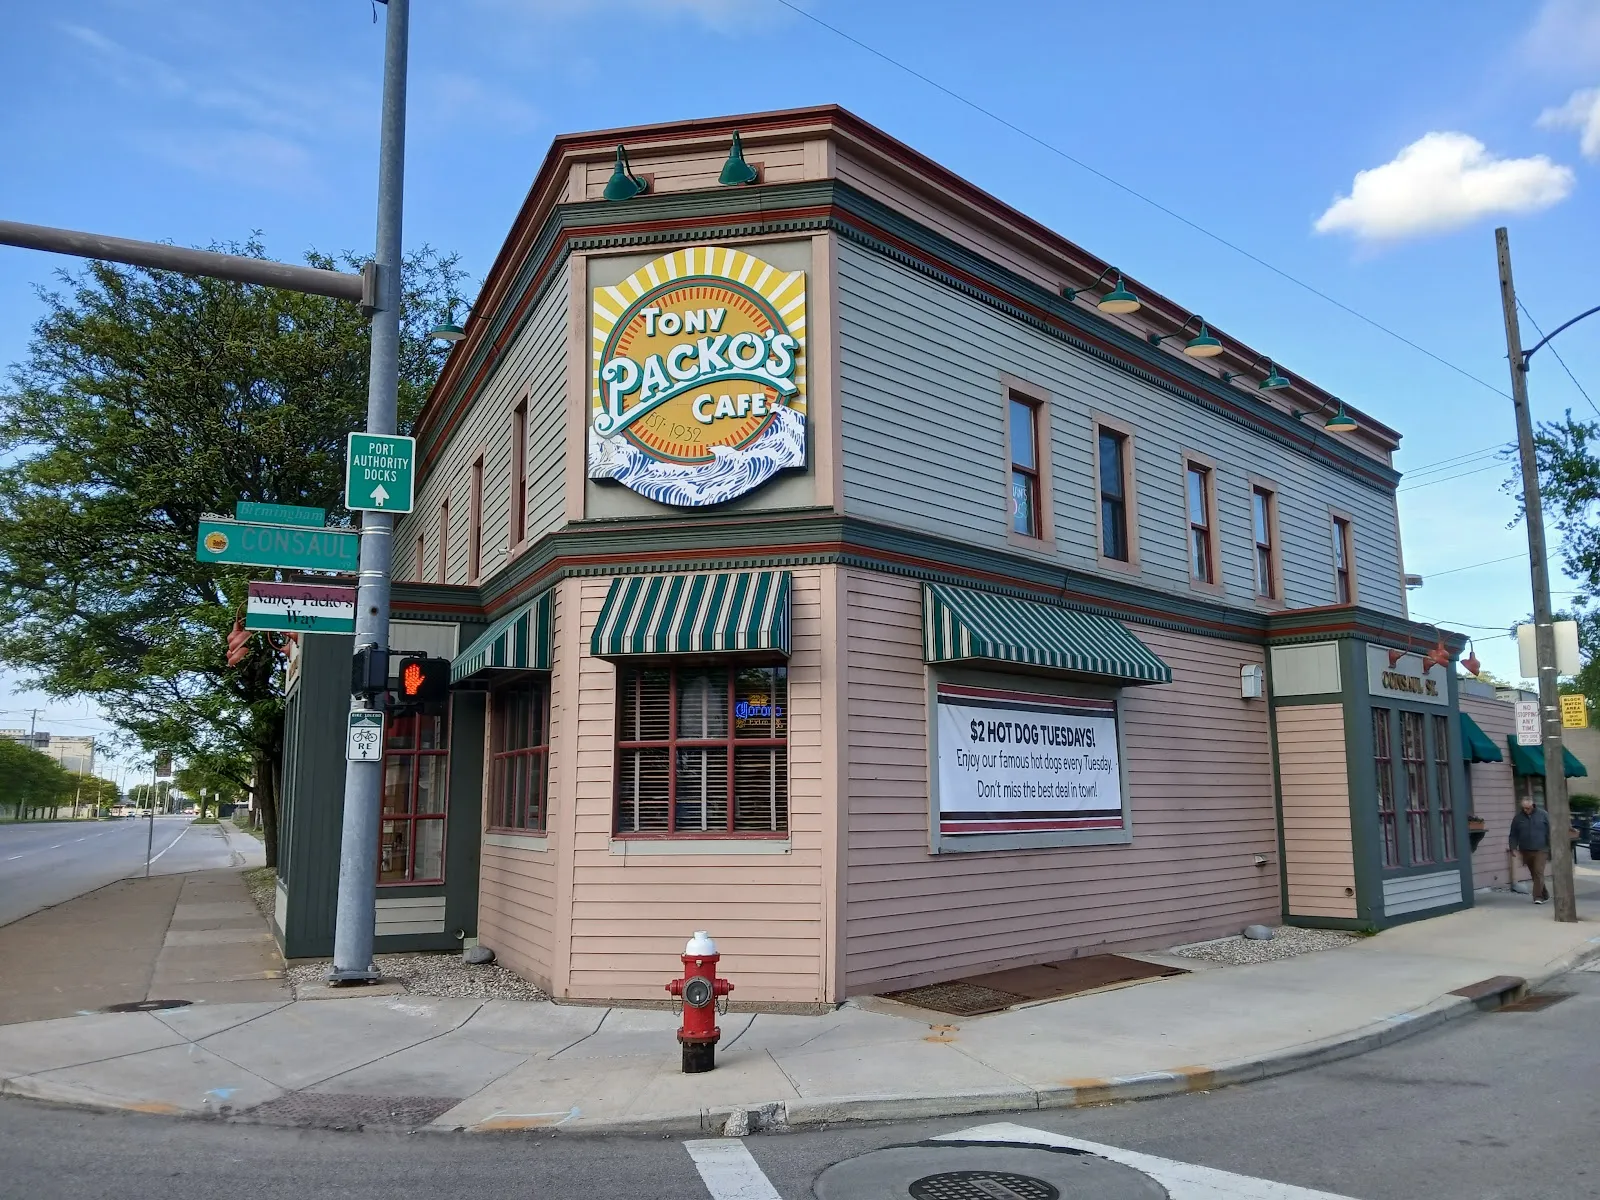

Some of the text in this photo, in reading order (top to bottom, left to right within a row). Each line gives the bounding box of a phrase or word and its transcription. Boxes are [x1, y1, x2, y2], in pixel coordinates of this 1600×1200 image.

[640, 307, 727, 336] TONY
[594, 328, 799, 437] PACKO'S
[692, 392, 769, 424] CAFE
[645, 411, 702, 442] EST. 1932
[369, 442, 395, 456] PORT
[353, 454, 409, 470] AUTHORITY
[364, 468, 397, 482] DOCKS
[240, 502, 324, 521] Birmingham
[241, 528, 351, 558] CONSAUL
[252, 589, 353, 609] Nancy Packo's
[286, 609, 319, 628] Way
[970, 718, 1096, 748] $2 HOT DOG TUESDAYS!
[956, 748, 1113, 775] Enjoy our famous hot dogs every Tuesday.
[977, 780, 1098, 798] Don't miss the best deal in town!
